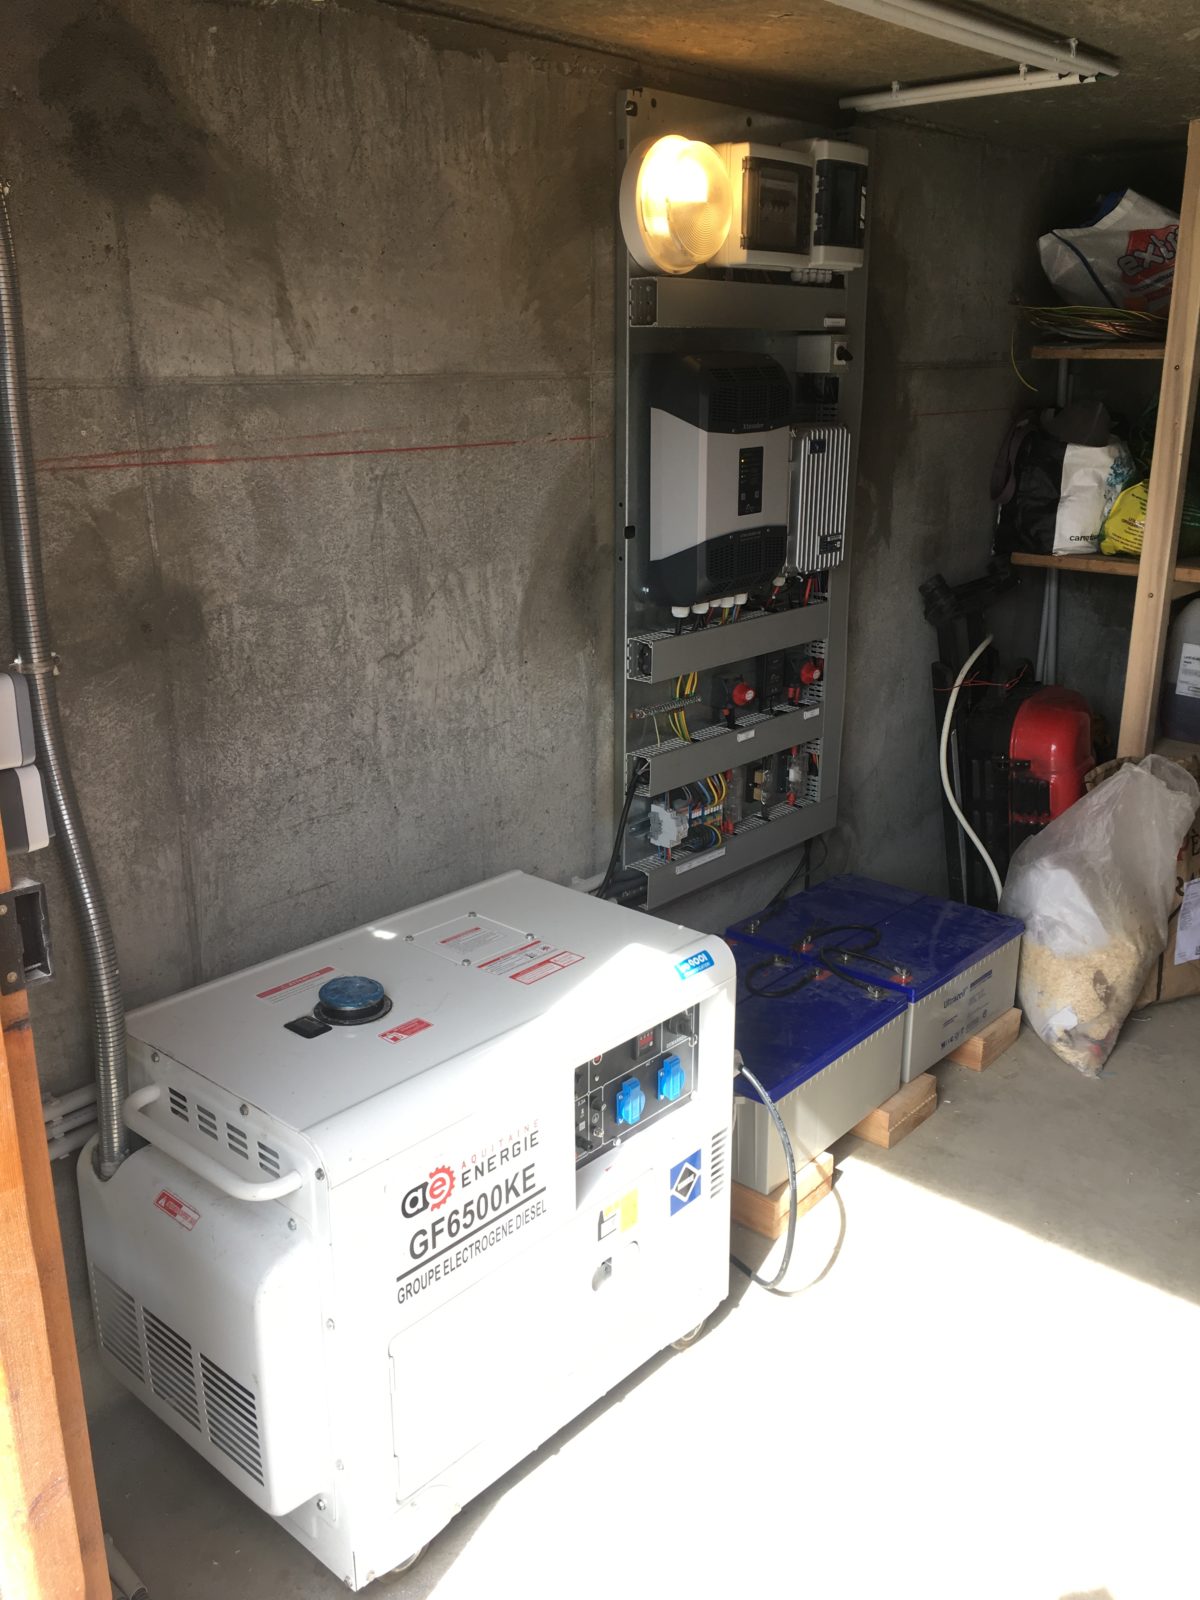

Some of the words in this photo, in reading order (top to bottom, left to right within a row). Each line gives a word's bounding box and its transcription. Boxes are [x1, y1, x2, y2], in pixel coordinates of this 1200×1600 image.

[461, 1119, 540, 1170] AQUITAINE
[461, 1130, 540, 1189] ENERGIE
[409, 1163, 537, 1260] GF6500KE
[397, 1264, 442, 1304] GROUPE
[443, 1218, 514, 1276] ELECTROGENE
[515, 1199, 548, 1231] DIESEL
